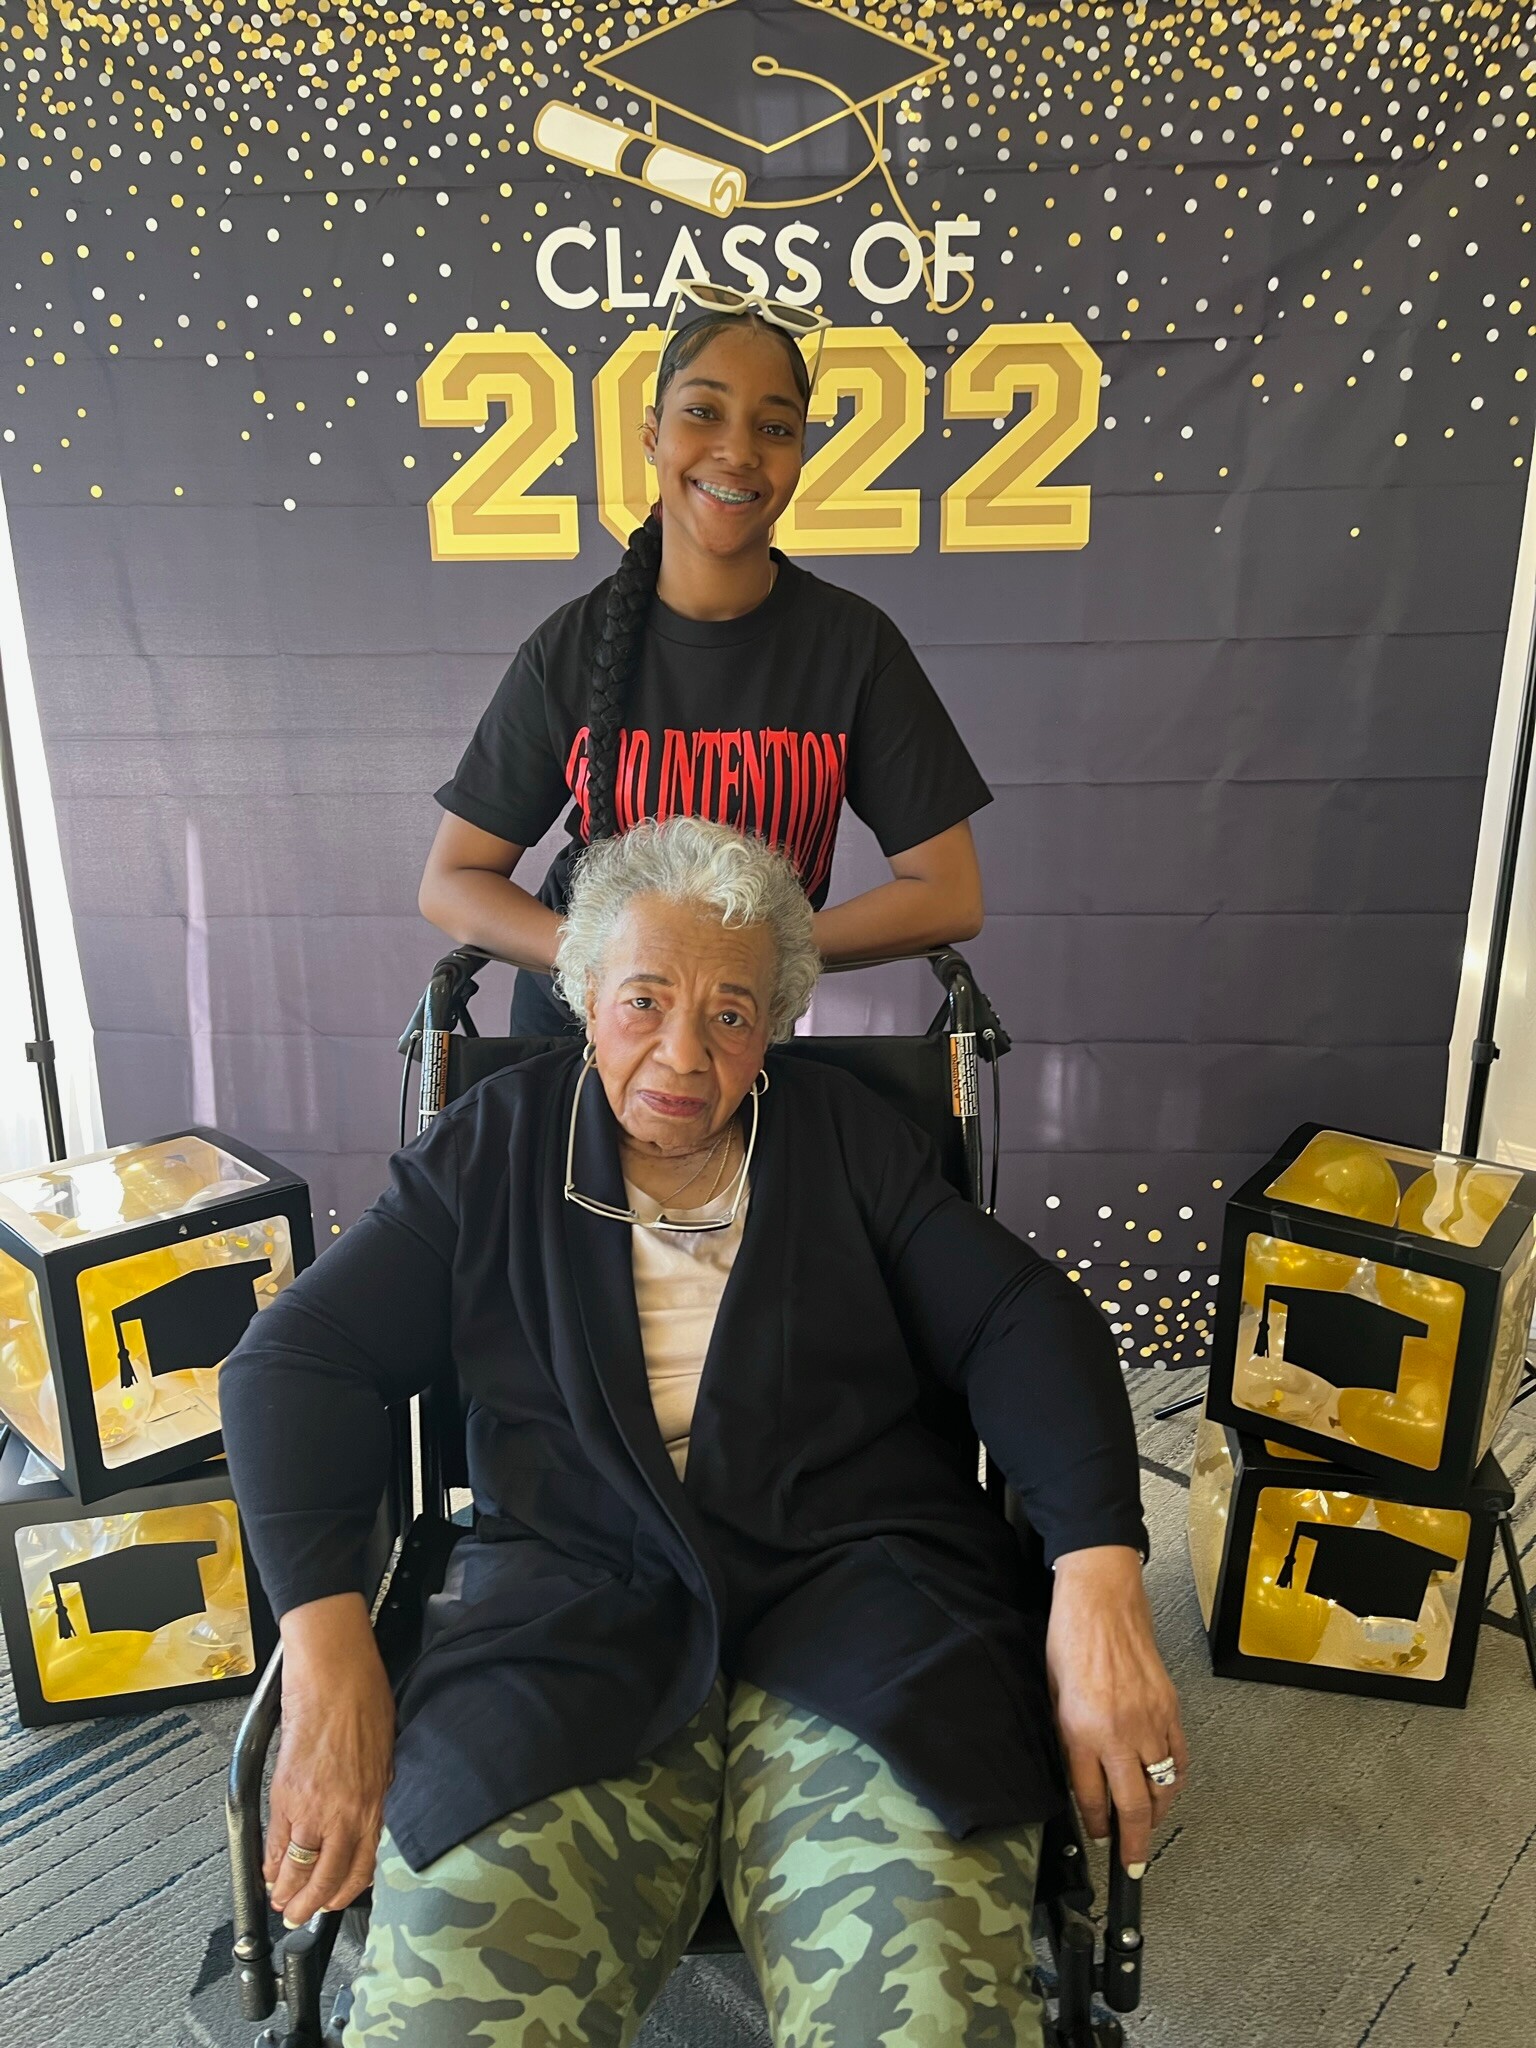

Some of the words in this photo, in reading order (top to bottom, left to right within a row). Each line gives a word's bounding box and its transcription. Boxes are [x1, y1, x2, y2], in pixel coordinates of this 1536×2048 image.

[535, 223, 822, 310] CLASS
[850, 220, 981, 304] OF
[565, 726, 650, 846] GD
[656, 726, 847, 897] INTENTION
